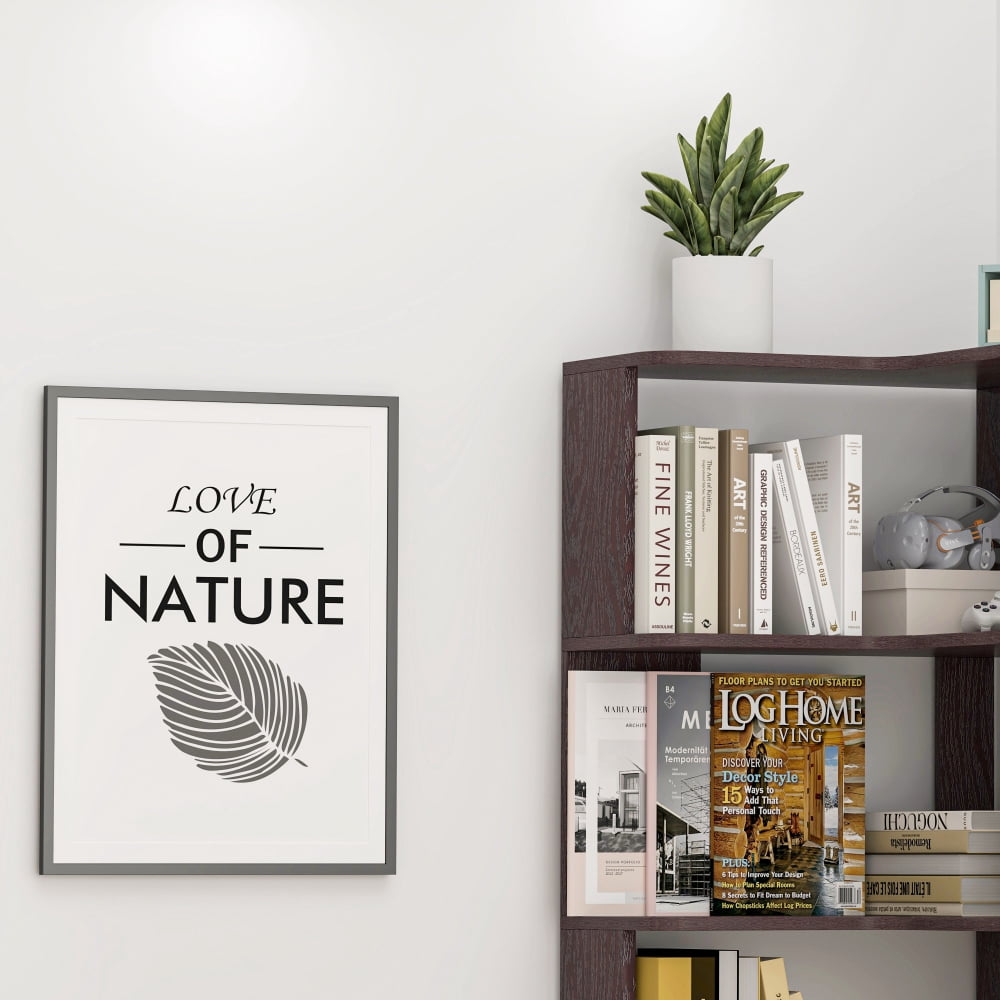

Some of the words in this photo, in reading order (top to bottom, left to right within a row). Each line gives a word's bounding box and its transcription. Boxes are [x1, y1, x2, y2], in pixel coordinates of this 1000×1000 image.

[168, 483, 277, 515] LOVE
[655, 462, 671, 516] FINE
[733, 477, 747, 510] ART
[760, 469, 768, 508] GRAPHIC
[848, 482, 861, 513] ART
[683, 490, 693, 514] FRANK
[683, 515, 693, 538] LLOYD
[760, 510, 768, 542] DESIGN
[196, 528, 252, 563] OF
[682, 539, 693, 568] WRIGHT
[789, 529, 806, 576] BORDEAUX
[810, 530, 824, 567] SAARINEN
[655, 527, 671, 607] WINES
[760, 544, 768, 600] REFERENCED
[819, 569, 828, 587] EERO
[104, 573, 344, 625] NATURE
[718, 677, 745, 686] FLOOR
[748, 677, 774, 686] PLANS
[776, 677, 787, 686] TO
[789, 678, 805, 686] GET
[808, 678, 824, 687] YOU
[826, 678, 862, 687] STARTED
[604, 705, 630, 713] MARIA
[761, 728, 823, 743] LIVING
[665, 746, 708, 754] Modernität
[722, 757, 761, 768] DISCOVER
[762, 757, 783, 768] YOUR
[722, 771, 761, 783] Decor
[764, 771, 798, 786] Style
[722, 786, 742, 804] 15
[744, 786, 764, 795] Ways
[766, 786, 774, 794] to
[744, 797, 760, 805] Add
[762, 797, 779, 805] That
[722, 807, 756, 815] Personal
[758, 807, 781, 815] Touch
[883, 812, 948, 830] NOGUCHI
[890, 838, 932, 851] Remodelista
[722, 858, 751, 868] PLUS:
